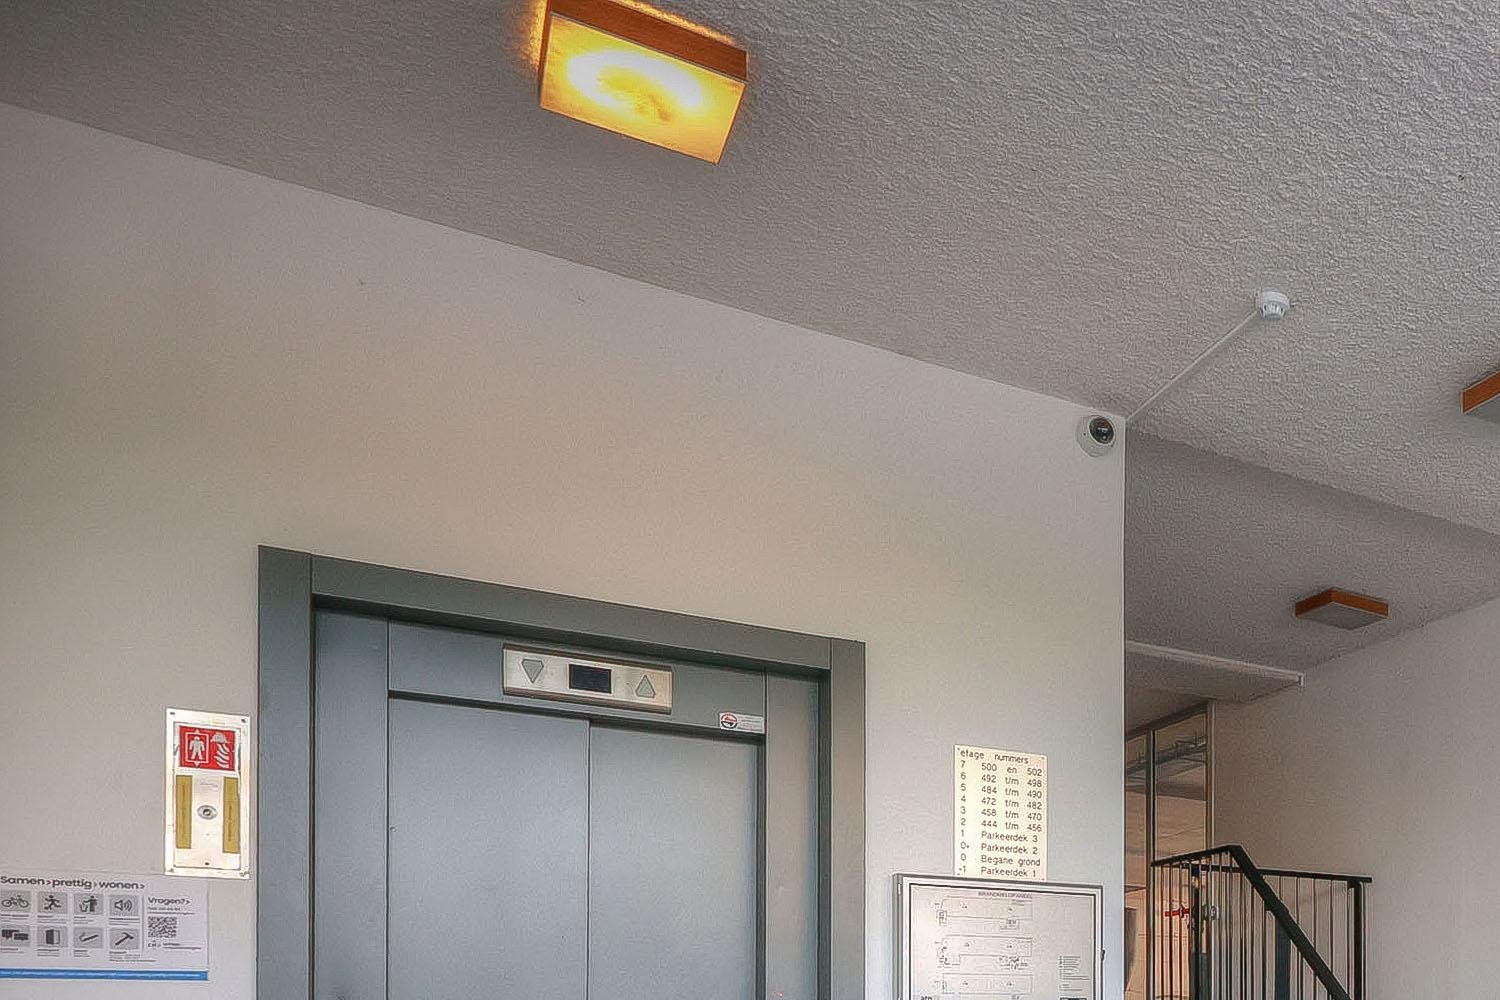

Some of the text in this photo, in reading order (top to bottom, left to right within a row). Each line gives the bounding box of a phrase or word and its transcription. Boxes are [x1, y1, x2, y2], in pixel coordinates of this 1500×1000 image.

[994, 754, 1029, 764] nummers
[960, 760, 1042, 776] 7 500 en 502
[960, 772, 1042, 787] 6 492 t/m 498
[960, 783, 1042, 799] 5 484 t/m 490
[981, 797, 997, 805] 472
[1005, 800, 1019, 808] t/m
[1026, 801, 1042, 810] 482
[960, 806, 966, 814] 3
[1005, 811, 1019, 819] t/m
[1026, 812, 1042, 821] 470
[960, 818, 966, 826] 2
[981, 820, 997, 828] 444
[1005, 822, 1019, 830] t/m
[981, 831, 1028, 842] Parkeerdek
[1032, 835, 1038, 843] 3
[981, 843, 1028, 854] Parkeerdek
[1032, 847, 1038, 855] 2
[960, 853, 1041, 867] 0 Begane grond
[981, 866, 1028, 877] Parkeerdek
